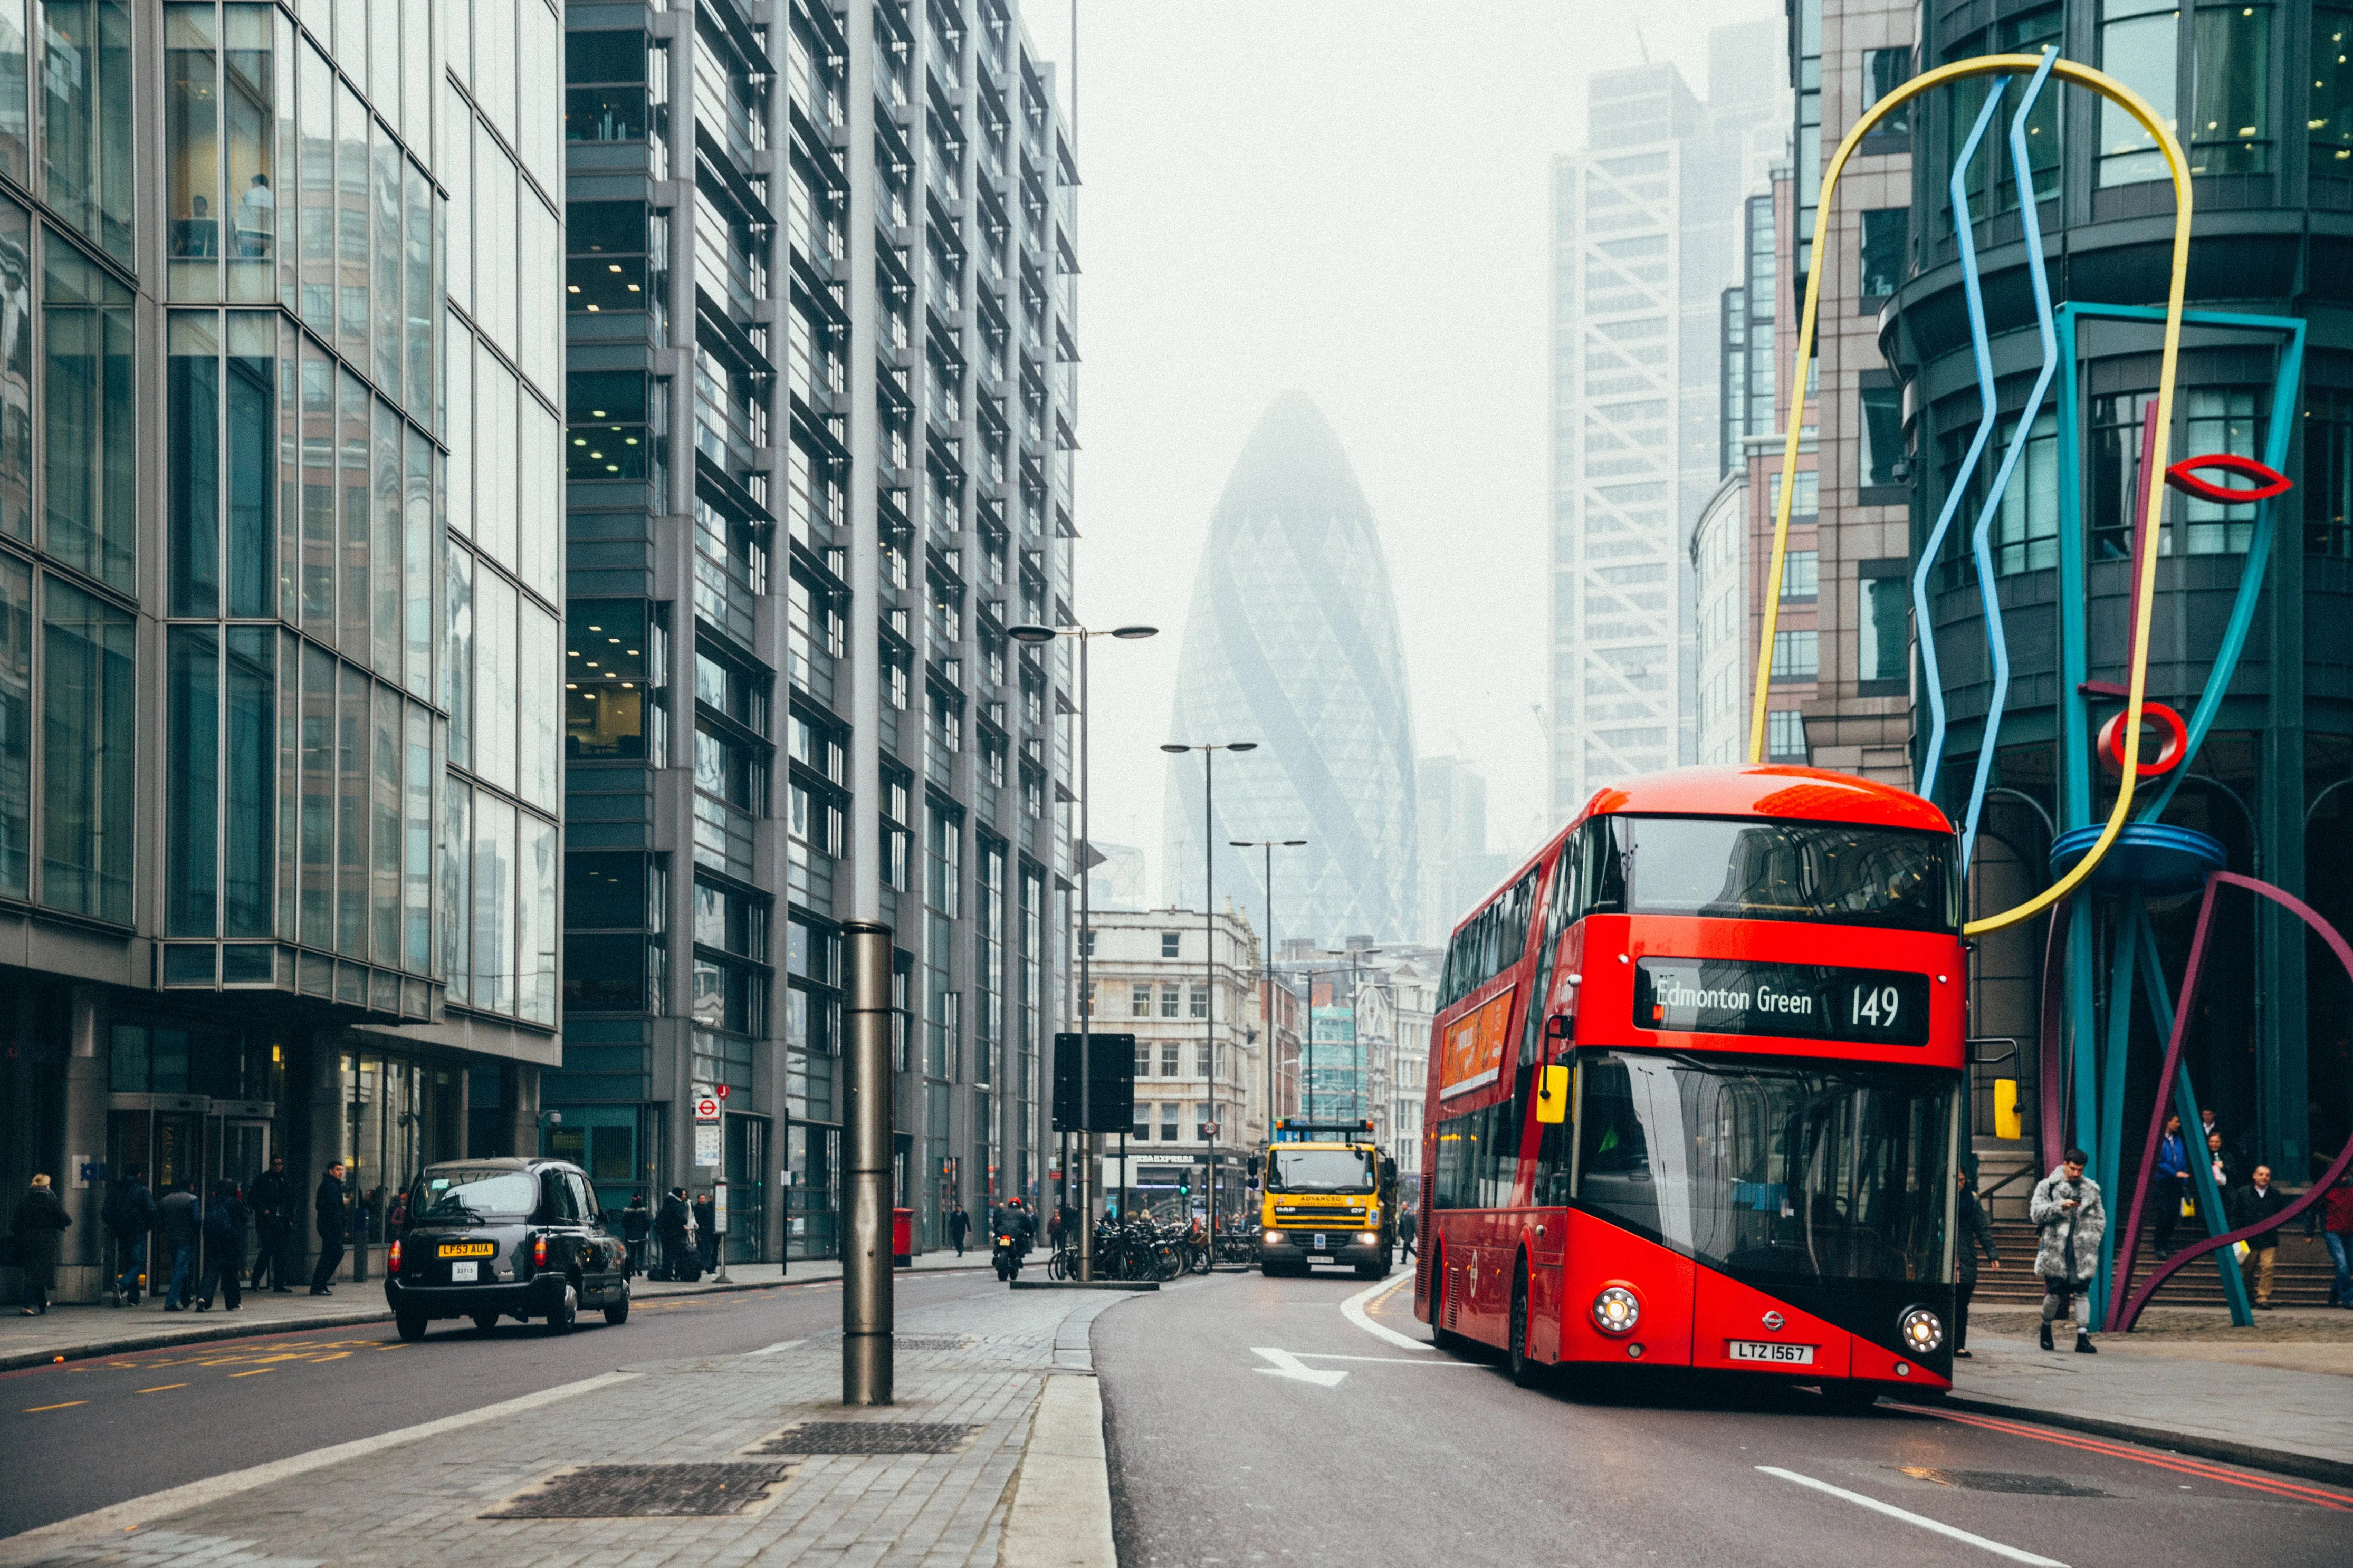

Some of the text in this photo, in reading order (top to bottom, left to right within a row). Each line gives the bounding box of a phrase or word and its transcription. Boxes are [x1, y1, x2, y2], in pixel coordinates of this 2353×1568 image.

[1656, 980, 1812, 1014] Edmonton Green
[1852, 985, 1899, 1027] 149
[720, 1086, 726, 1096] J
[444, 1244, 489, 1254] LF53 AUA
[1739, 1343, 1804, 1361] LTZ 1567
